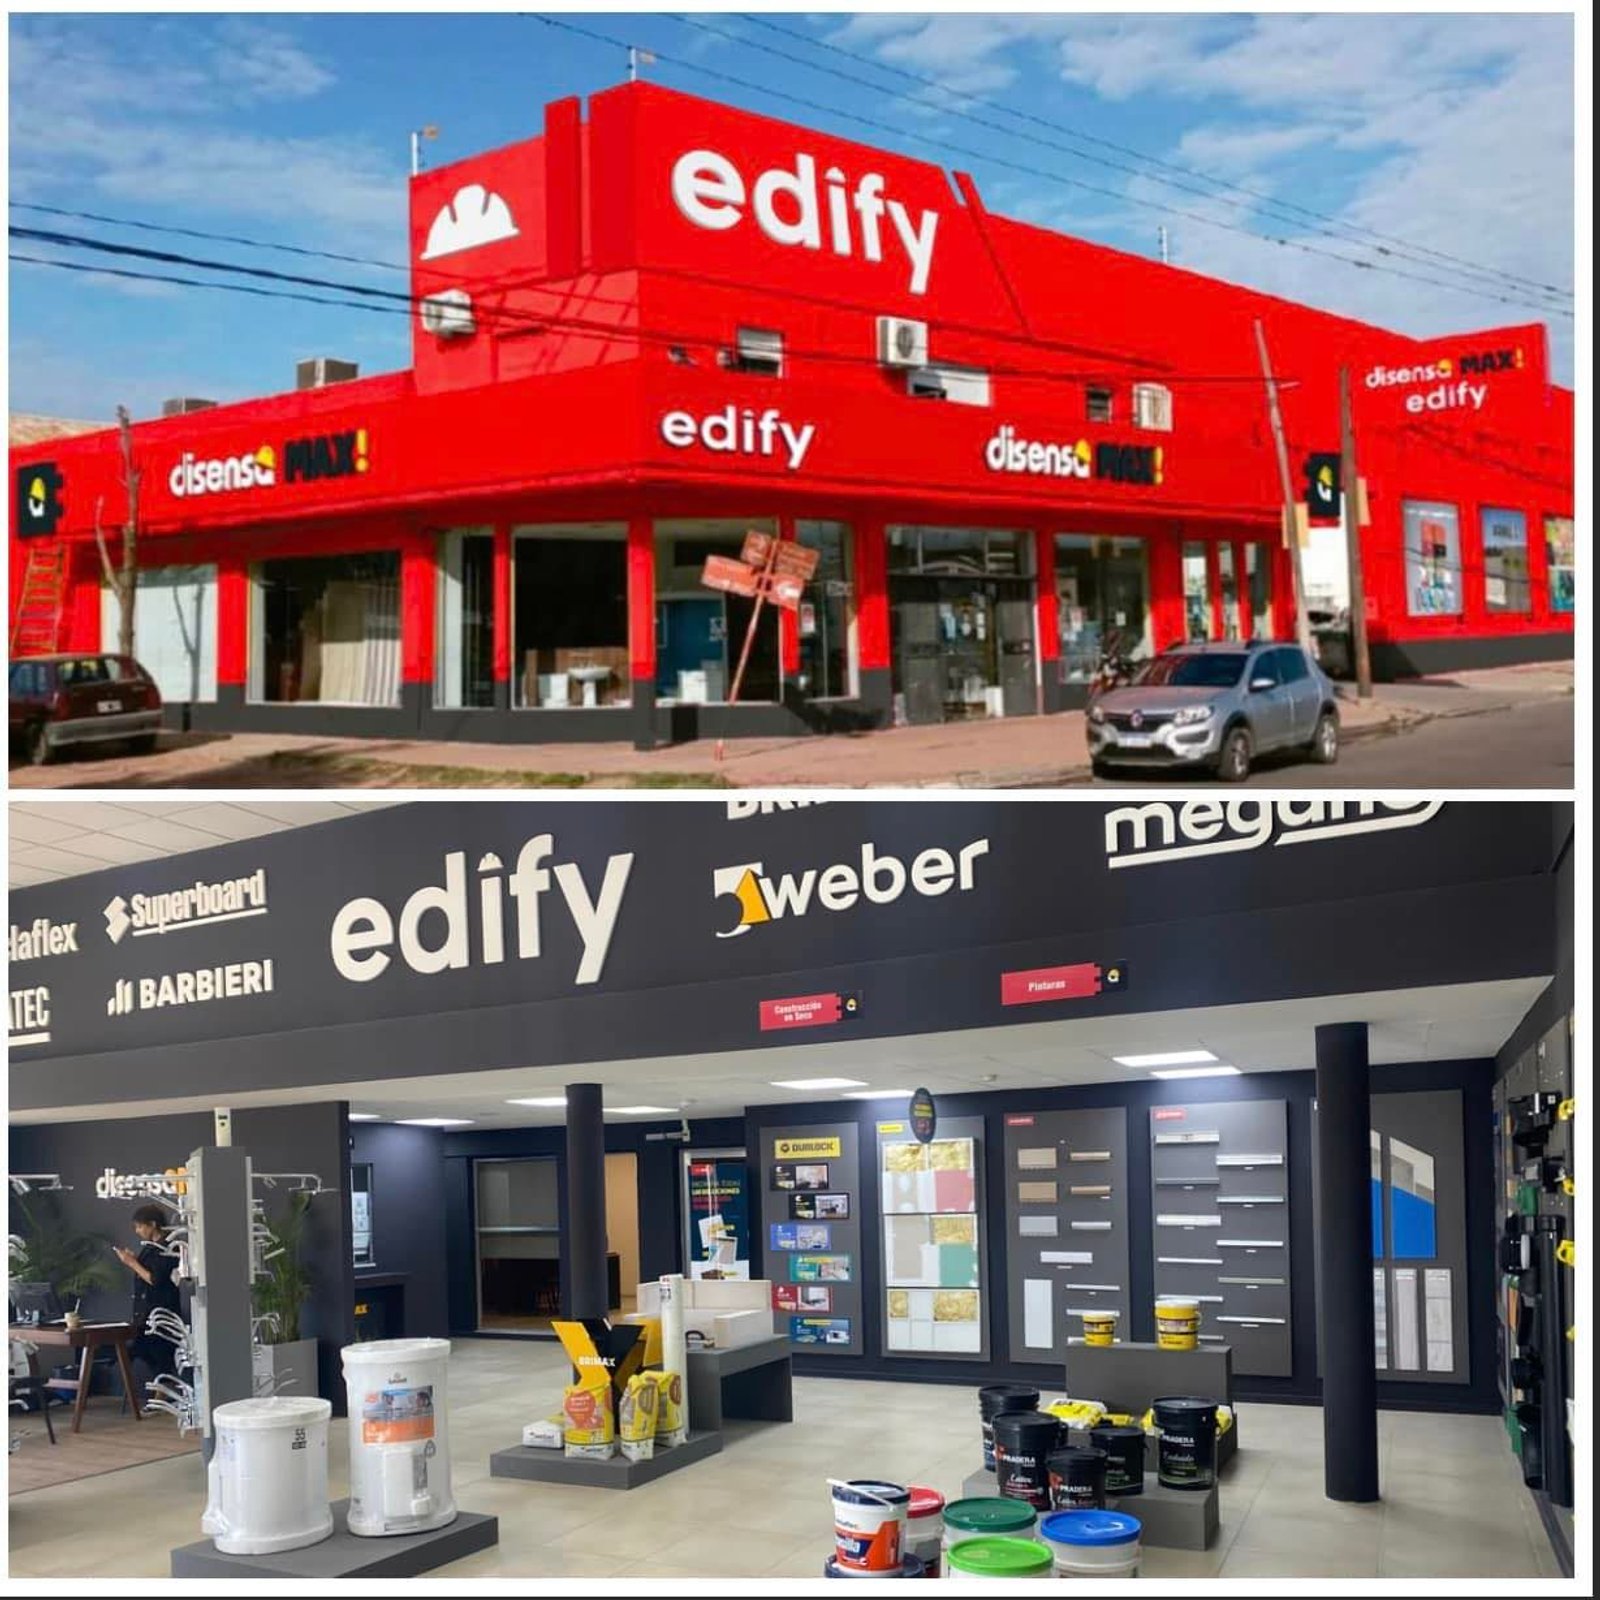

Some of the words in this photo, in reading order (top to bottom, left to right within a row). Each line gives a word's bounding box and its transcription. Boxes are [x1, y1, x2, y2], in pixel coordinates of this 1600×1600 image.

[671, 149, 939, 295] edify
[1365, 359, 1452, 389] disensa
[1459, 348, 1525, 376] MAX!
[1405, 383, 1488, 414] edify
[168, 445, 277, 498] disensa
[284, 428, 370, 482] MAX!
[661, 404, 816, 471] edify
[985, 425, 1092, 478] disensa
[1096, 442, 1164, 485] MAX!
[1105, 801, 1445, 869] mega
[130, 868, 267, 932] Superboard
[758, 838, 990, 920] weber
[331, 834, 635, 984] edify
[8, 919, 80, 962] laflex
[139, 959, 275, 1010] BARBIERI
[1028, 979, 1066, 993] Pinturas
[791, 1142, 834, 1153] DURLOCK
[578, 1356, 616, 1367] BRIMAX
[1002, 1456, 1036, 1464] PRADERA
